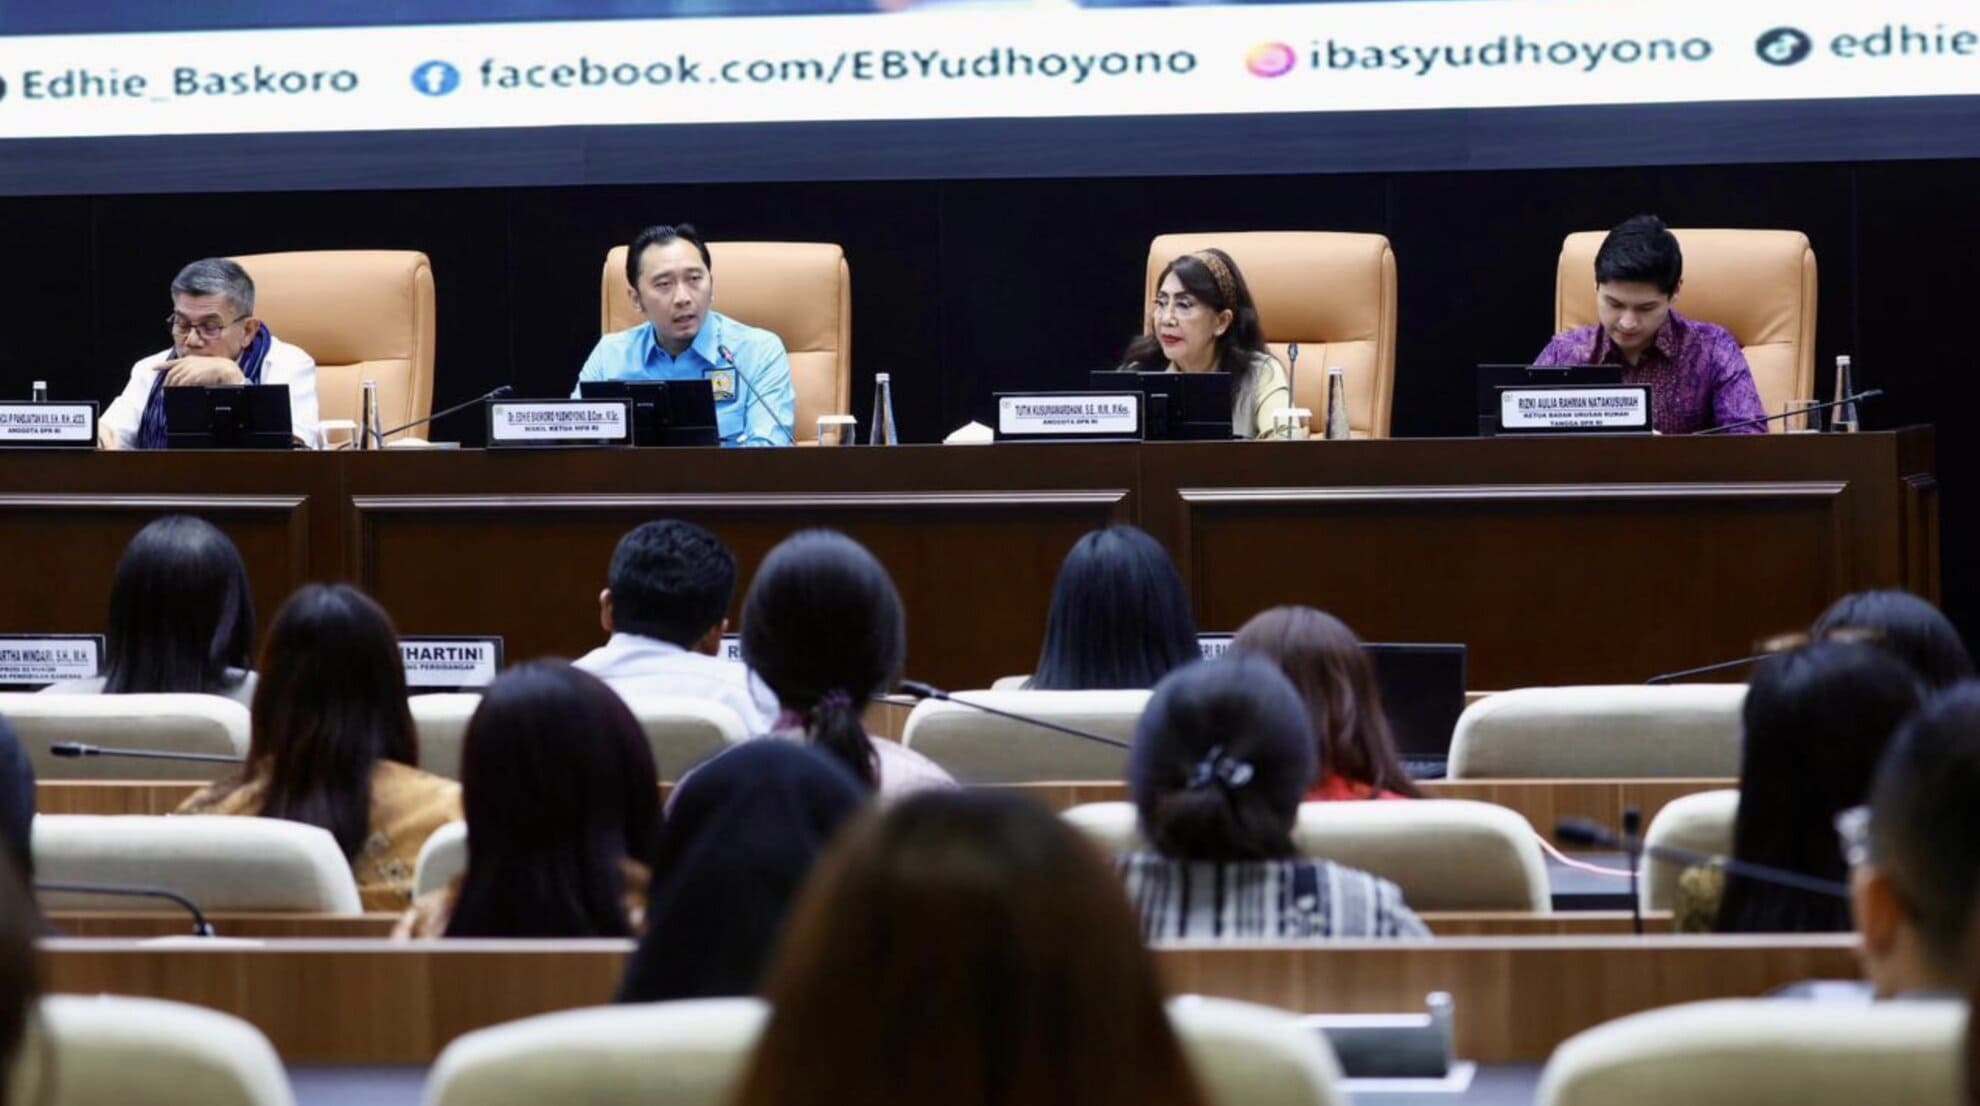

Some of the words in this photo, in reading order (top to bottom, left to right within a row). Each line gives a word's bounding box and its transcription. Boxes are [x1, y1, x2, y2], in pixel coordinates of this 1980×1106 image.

[1311, 36, 1713, 77] ibasyudhoyono
[1830, 23, 1978, 58] edhie
[23, 66, 359, 101] Edhie_Baskoro
[479, 47, 1198, 88] facebook.com/EBYudhoyono
[1518, 397, 1536, 409] RIZKI
[1538, 397, 1557, 408] AULIA
[1558, 397, 1587, 408] RAHMAN
[1588, 396, 1638, 408] NATAKUSUMAH
